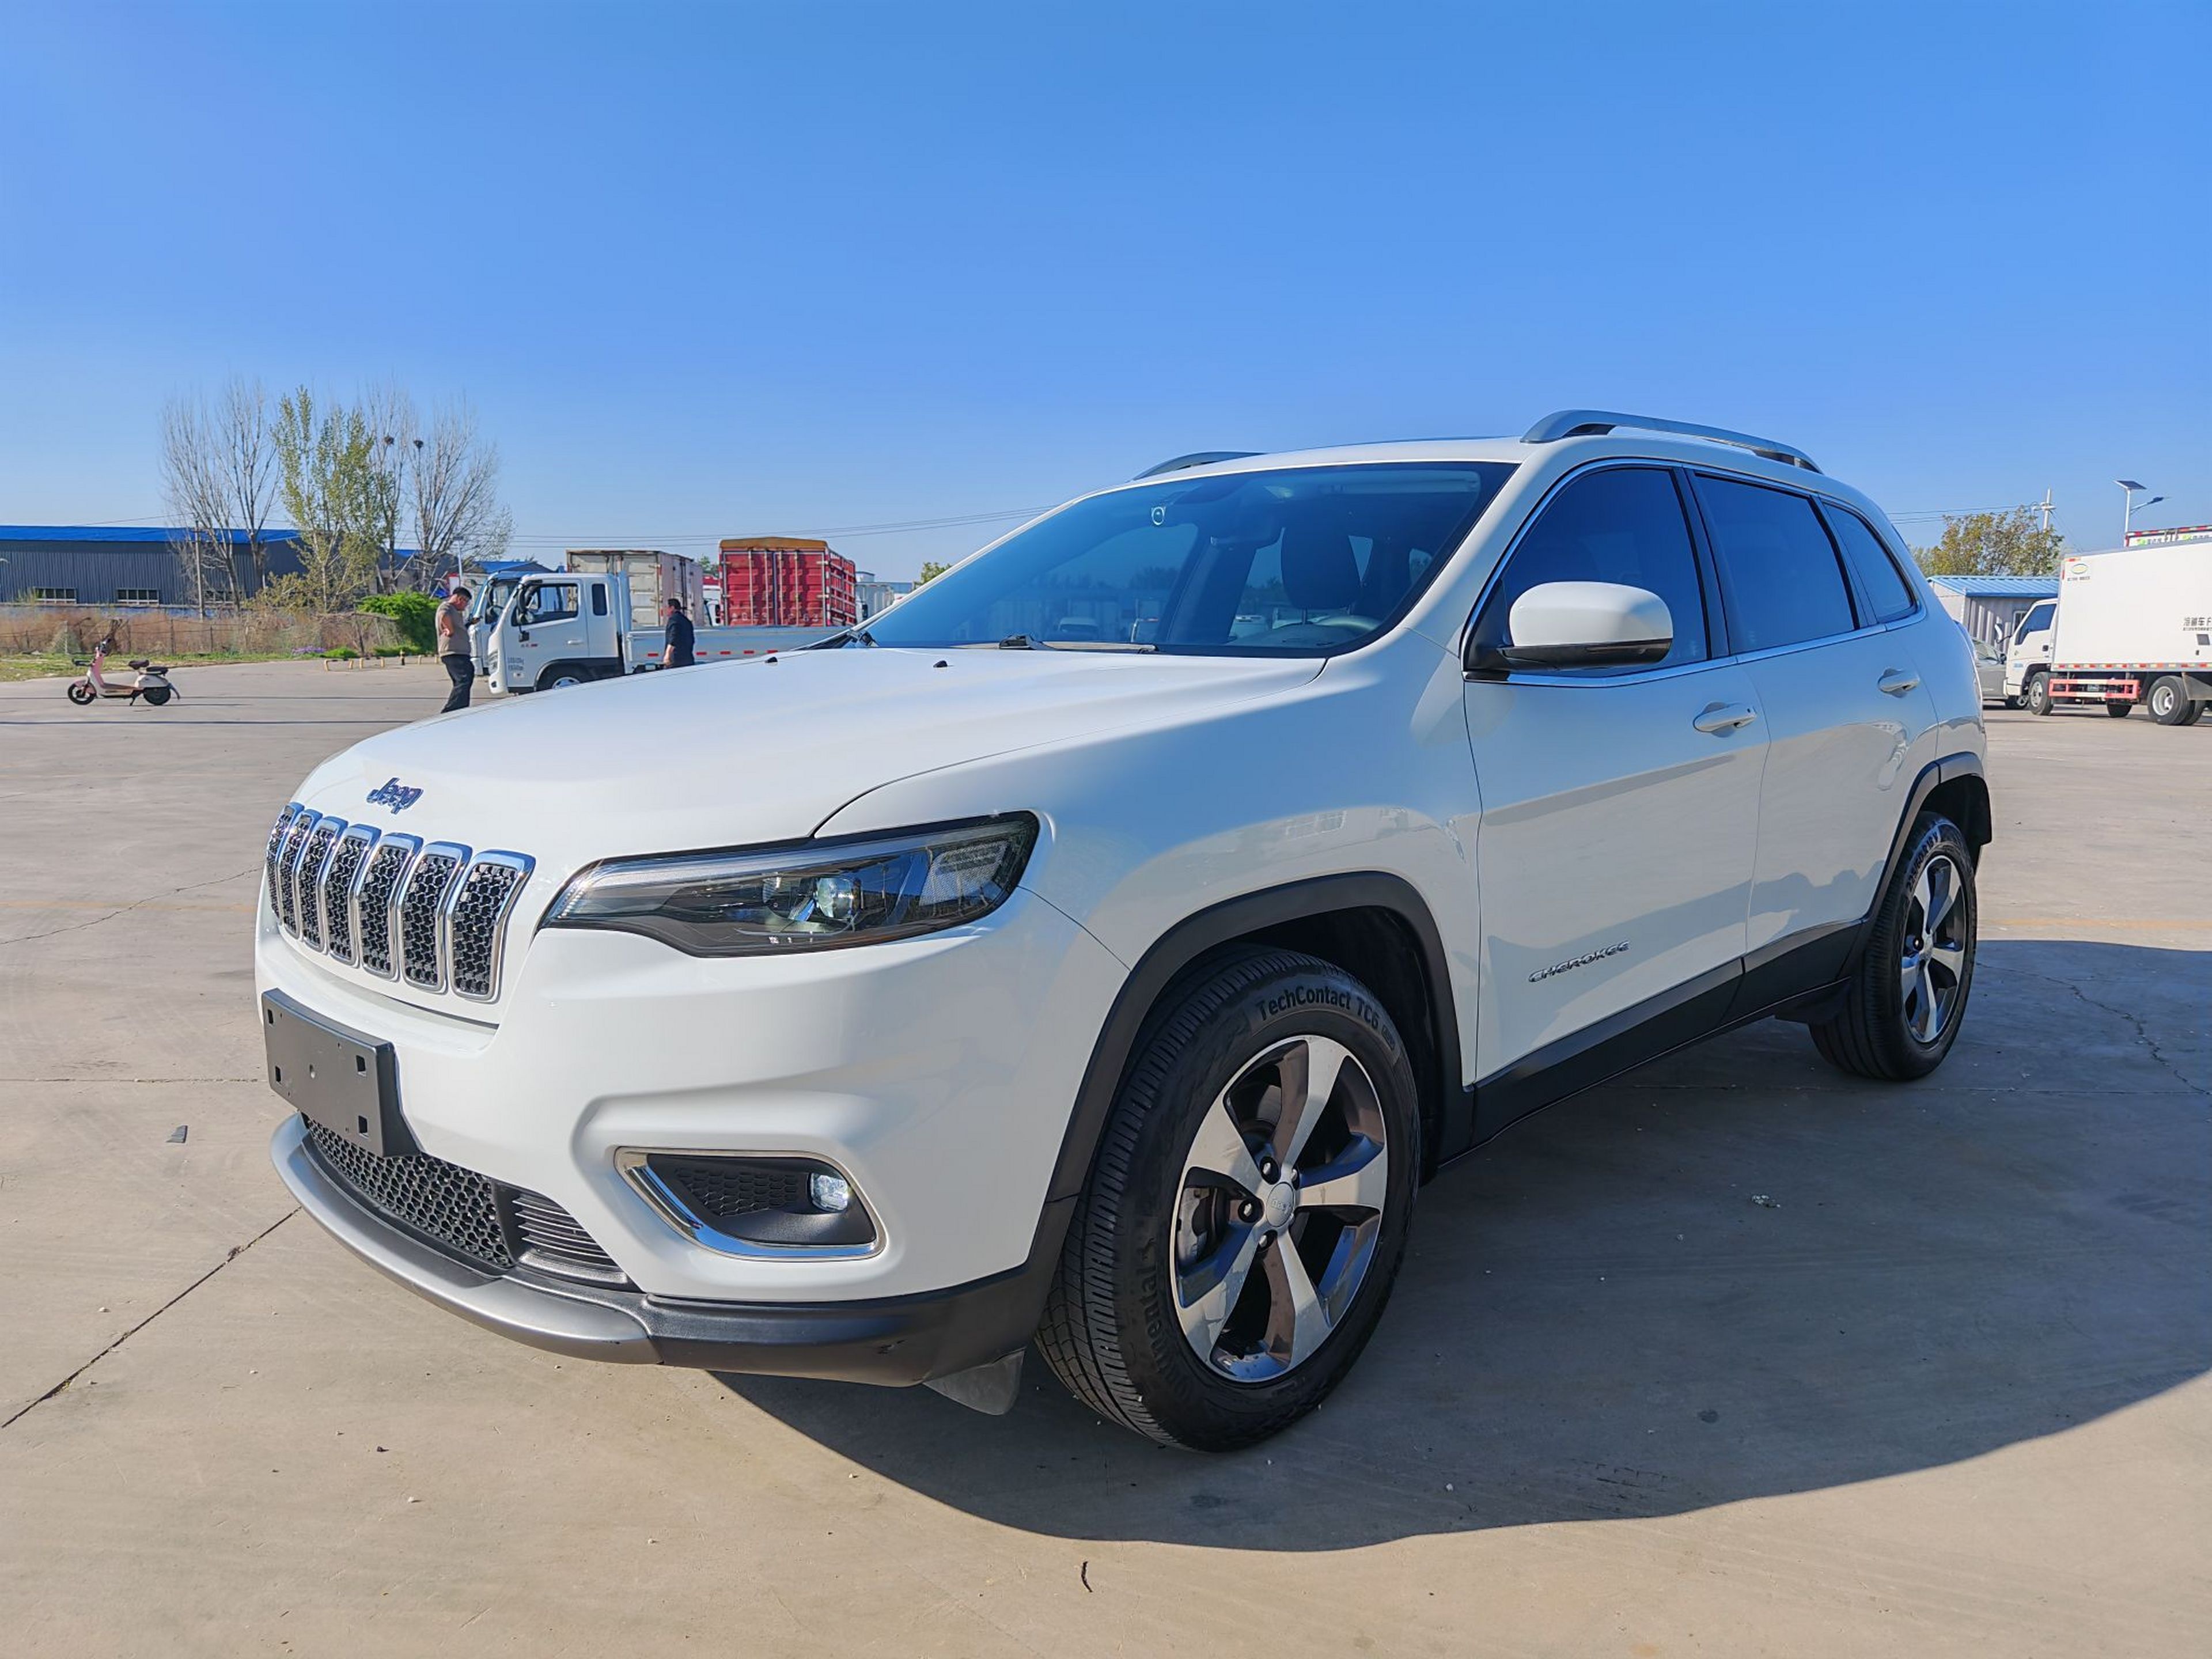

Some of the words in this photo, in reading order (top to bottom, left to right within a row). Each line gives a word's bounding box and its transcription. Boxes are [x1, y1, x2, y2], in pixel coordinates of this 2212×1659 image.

[366, 777, 424, 815] Jeep
[1528, 940, 1630, 982] CHEROKEE
[1256, 986, 1351, 1021] TechContact
[1357, 997, 1379, 1029] TC6
